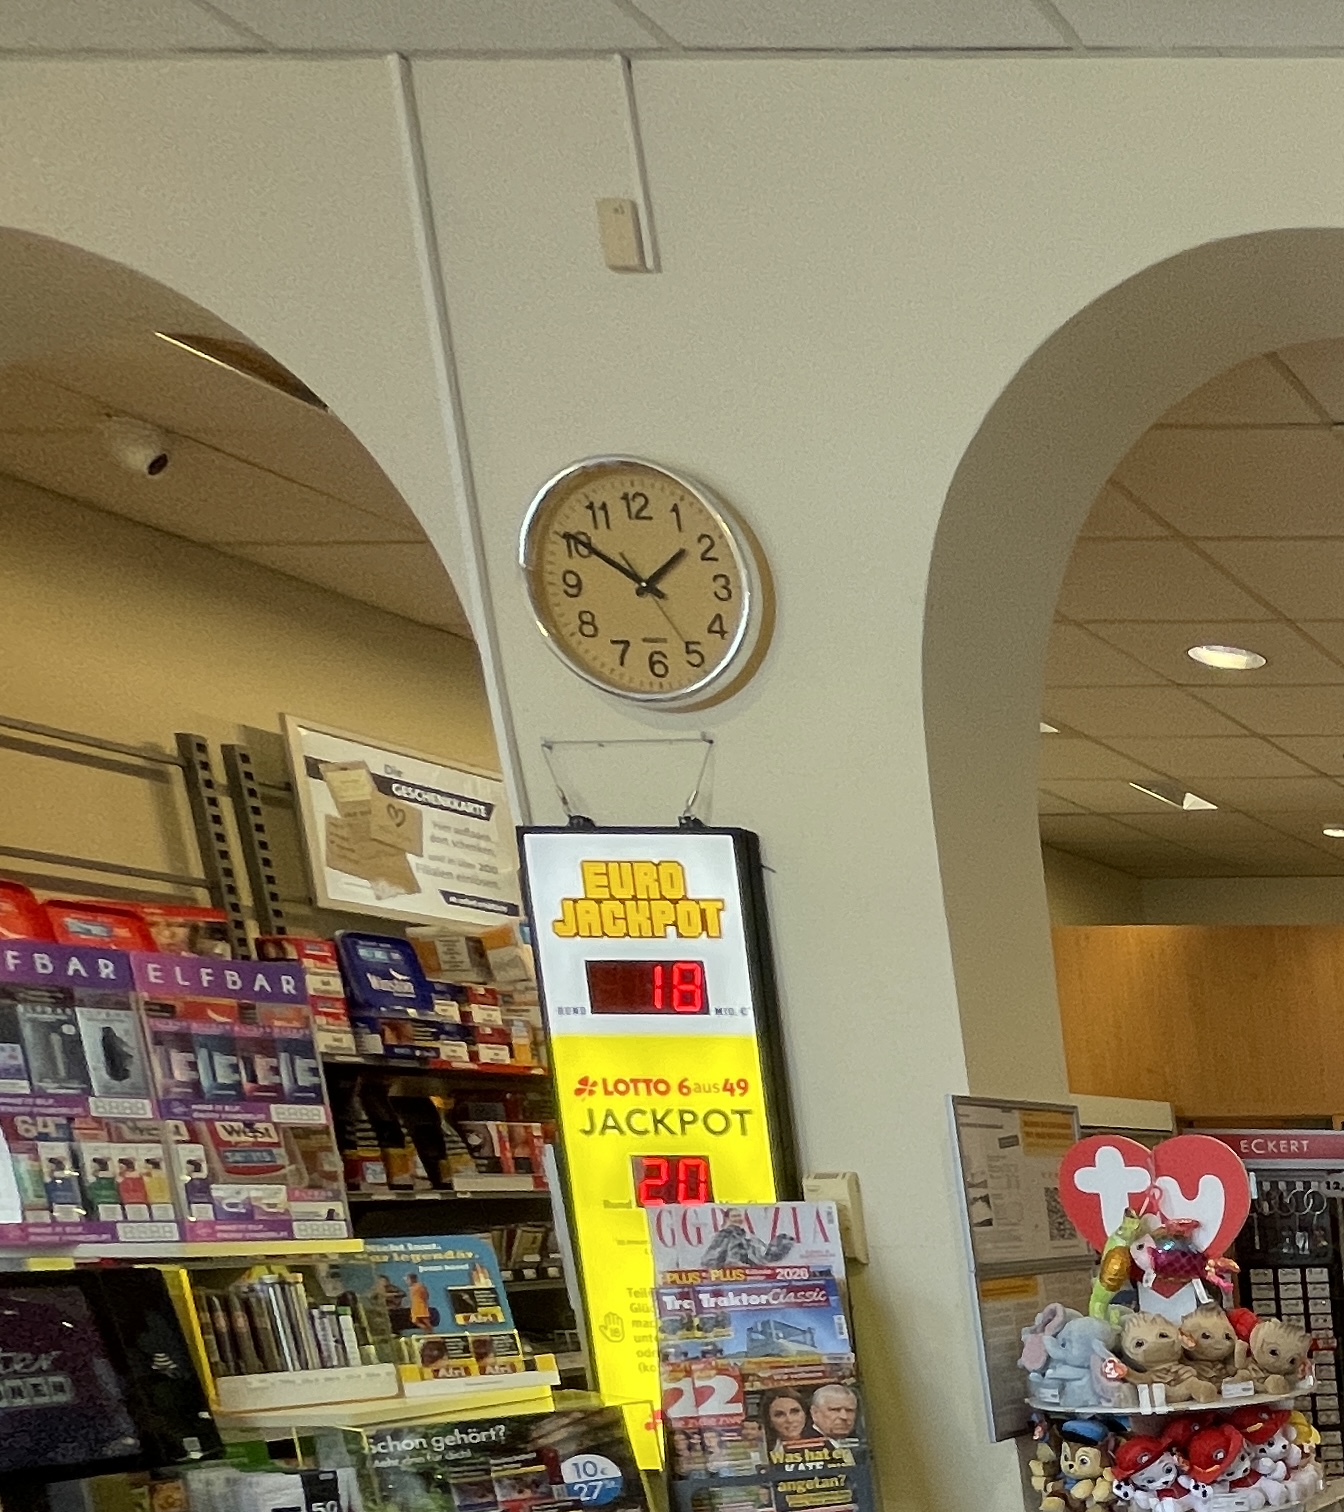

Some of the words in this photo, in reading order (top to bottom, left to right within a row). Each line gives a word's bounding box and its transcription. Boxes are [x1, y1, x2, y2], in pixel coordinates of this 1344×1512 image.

[586, 501, 612, 531] 11
[621, 491, 653, 520] 12
[670, 502, 682, 532] 1
[697, 534, 719, 562] 2
[562, 569, 583, 598] 9
[712, 573, 732, 601] 3
[577, 610, 598, 638] 8
[707, 613, 728, 640] 4
[610, 639, 631, 667] 7
[648, 650, 669, 678] 6
[685, 641, 704, 668] 5
[580, 860, 688, 900] EURO
[552, 898, 725, 939] JACKPOT
[147, 962, 298, 995] ELFBAR
[653, 962, 703, 1013] 18
[603, 1077, 671, 1097] LOTTO
[217, 1122, 277, 1140] West
[579, 1108, 754, 1138] JACKPOT
[1240, 1138, 1310, 1155] ECKERT
[639, 1157, 708, 1207] 20
[710, 1268, 746, 1282] PLUS
[431, 1424, 506, 1449] gehört?
[572, 1461, 598, 1478] 10
[770, 1450, 802, 1464] Was
[803, 1447, 832, 1464] hat
